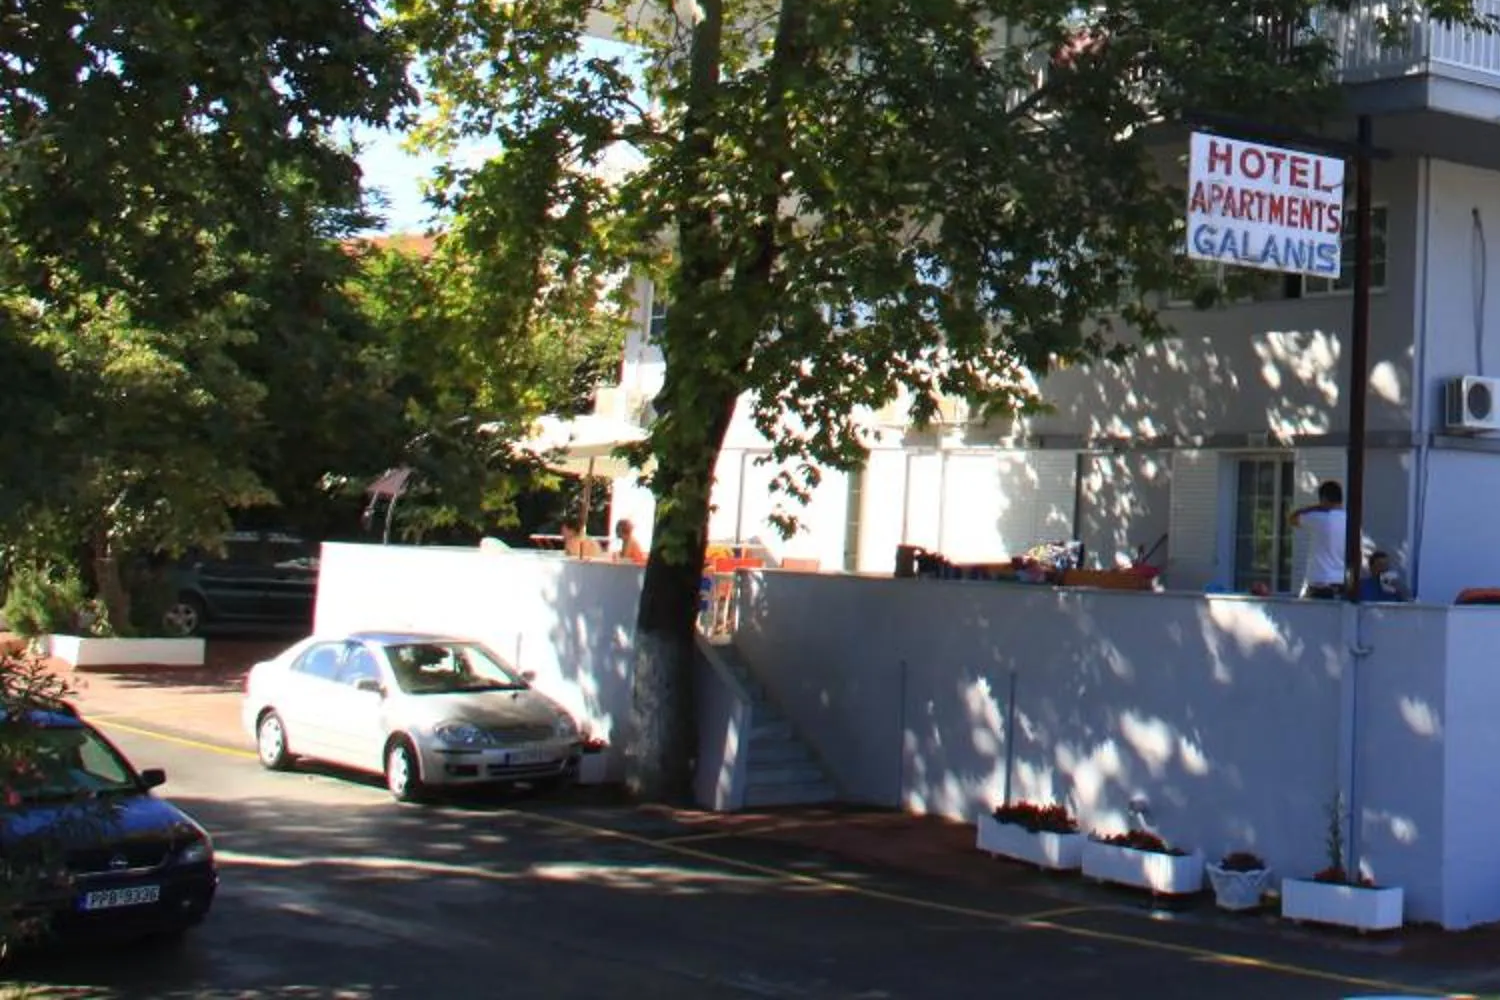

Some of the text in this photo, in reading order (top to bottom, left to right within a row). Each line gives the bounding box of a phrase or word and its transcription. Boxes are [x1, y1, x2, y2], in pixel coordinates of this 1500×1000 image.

[1208, 141, 1335, 193] HOTEL
[1190, 181, 1341, 234] APARTMENTS
[1194, 223, 1338, 273] GALANIS
